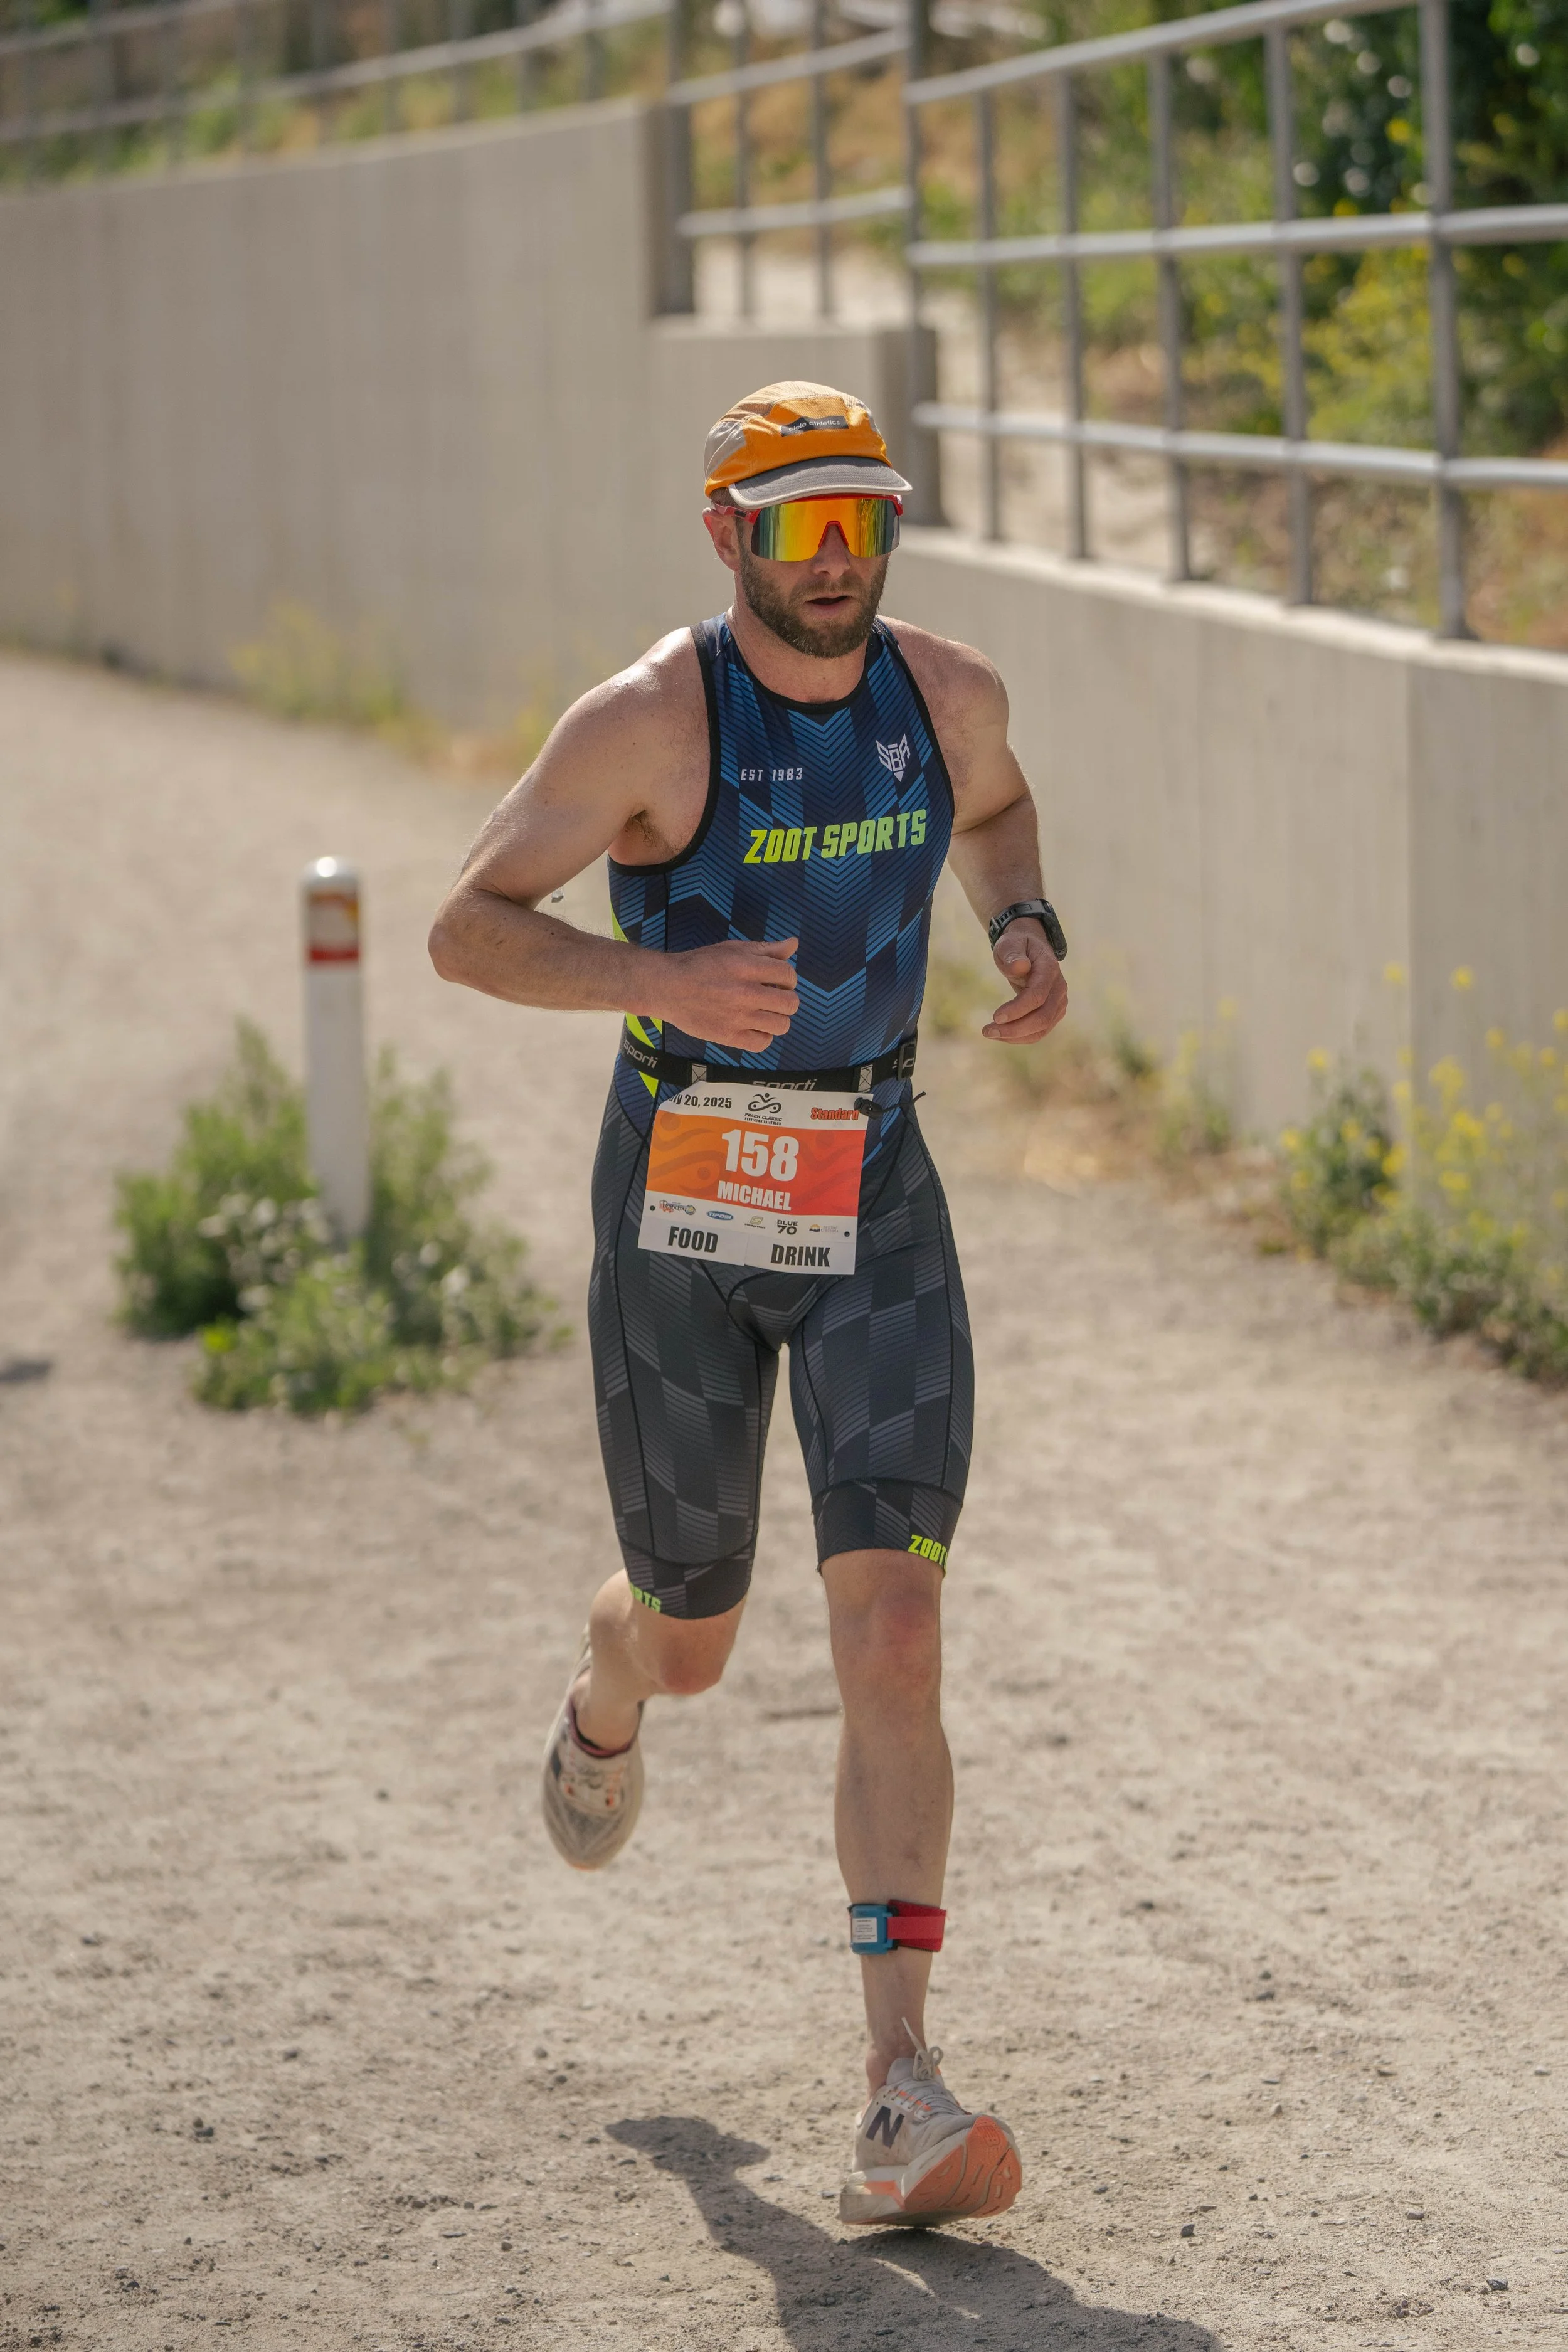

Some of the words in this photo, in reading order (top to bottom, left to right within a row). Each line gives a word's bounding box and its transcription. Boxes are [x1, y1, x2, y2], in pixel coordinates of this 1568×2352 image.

[741, 769, 763, 781] EST
[772, 768, 803, 781] 1983
[743, 826, 817, 864] ZOOT
[820, 808, 926, 859] SPORTS
[623, 1039, 659, 1069] sporti
[684, 1094, 701, 1108] 20,
[703, 1096, 733, 1109] 2025
[721, 1128, 800, 1182] 158
[717, 1180, 792, 1211] MICHAEL
[667, 1226, 719, 1253] FOOD
[777, 1225, 797, 1236] 70
[770, 1244, 831, 1268] DRINK
[908, 1534, 947, 1566] ZOOT
